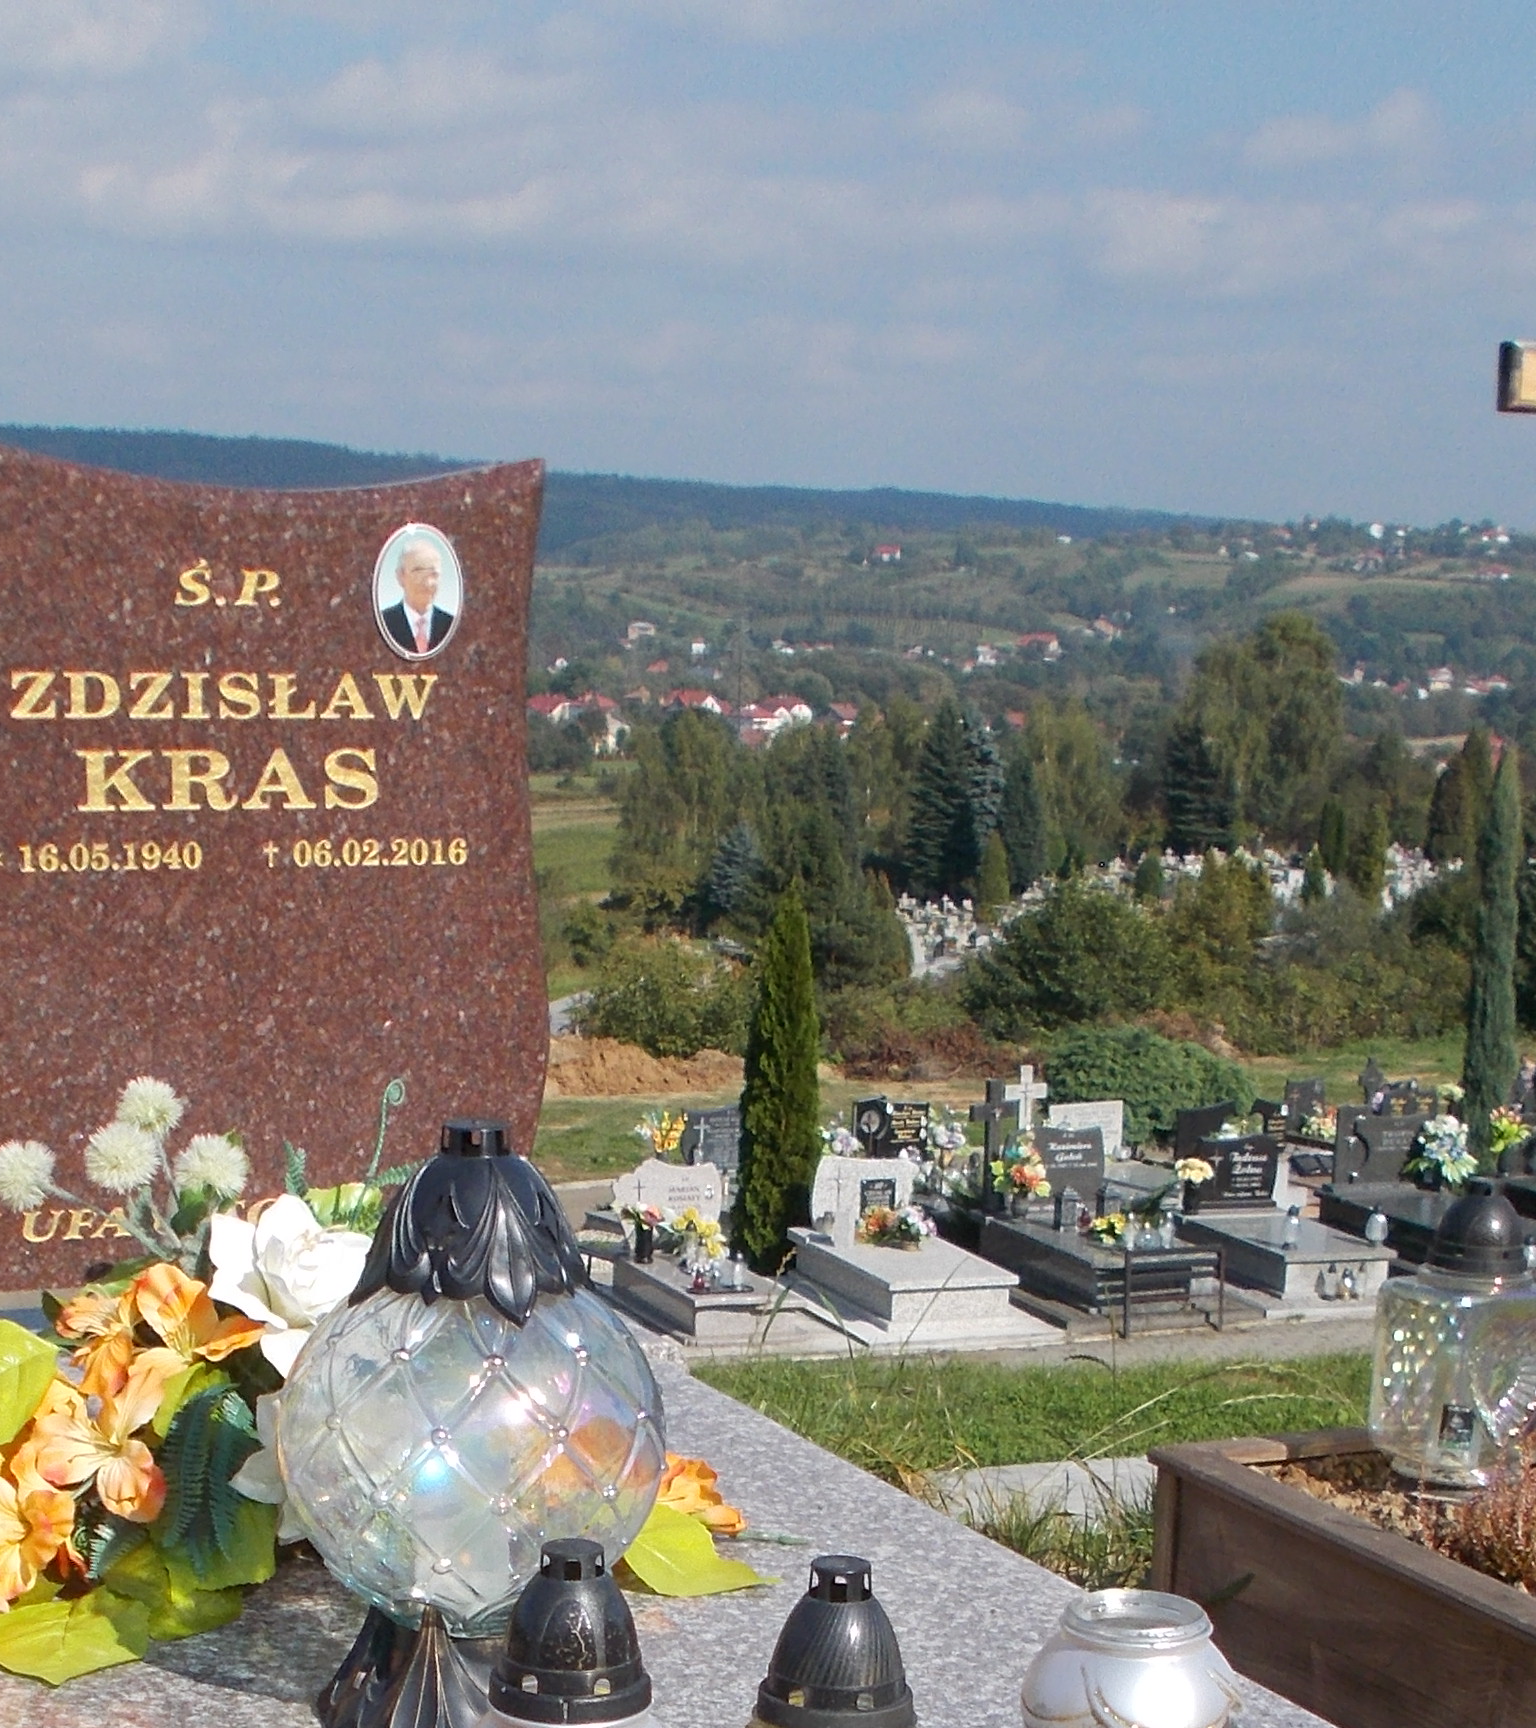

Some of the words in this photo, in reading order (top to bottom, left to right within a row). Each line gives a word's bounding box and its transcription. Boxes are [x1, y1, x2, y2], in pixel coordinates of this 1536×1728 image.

[174, 558, 282, 608] Ś.P.
[9, 670, 439, 721] ZDZISŁAW
[75, 747, 380, 813] KRAS
[17, 839, 203, 873] 16.05.1940
[292, 837, 468, 868] 06.02.2016
